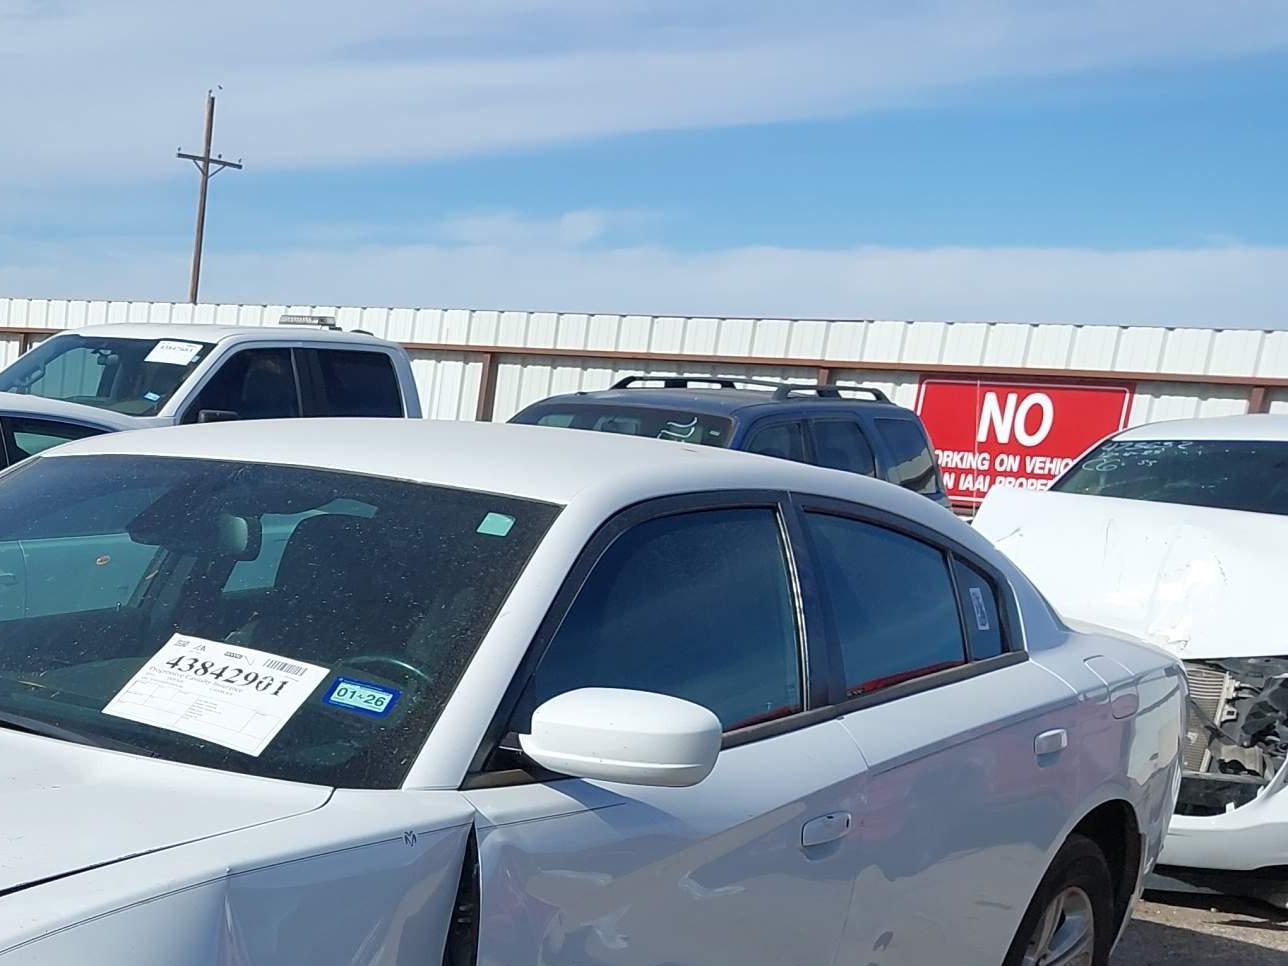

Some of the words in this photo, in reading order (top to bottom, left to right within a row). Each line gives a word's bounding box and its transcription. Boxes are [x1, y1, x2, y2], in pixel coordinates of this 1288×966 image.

[976, 391, 1054, 447] NO
[934, 449, 991, 471] ORKING
[994, 453, 1021, 473] ON
[1025, 455, 1073, 475] VEHIC
[942, 472, 956, 490] N
[958, 473, 991, 492] IAAI
[995, 475, 1050, 492] PROPE
[165, 654, 289, 697] 43842901
